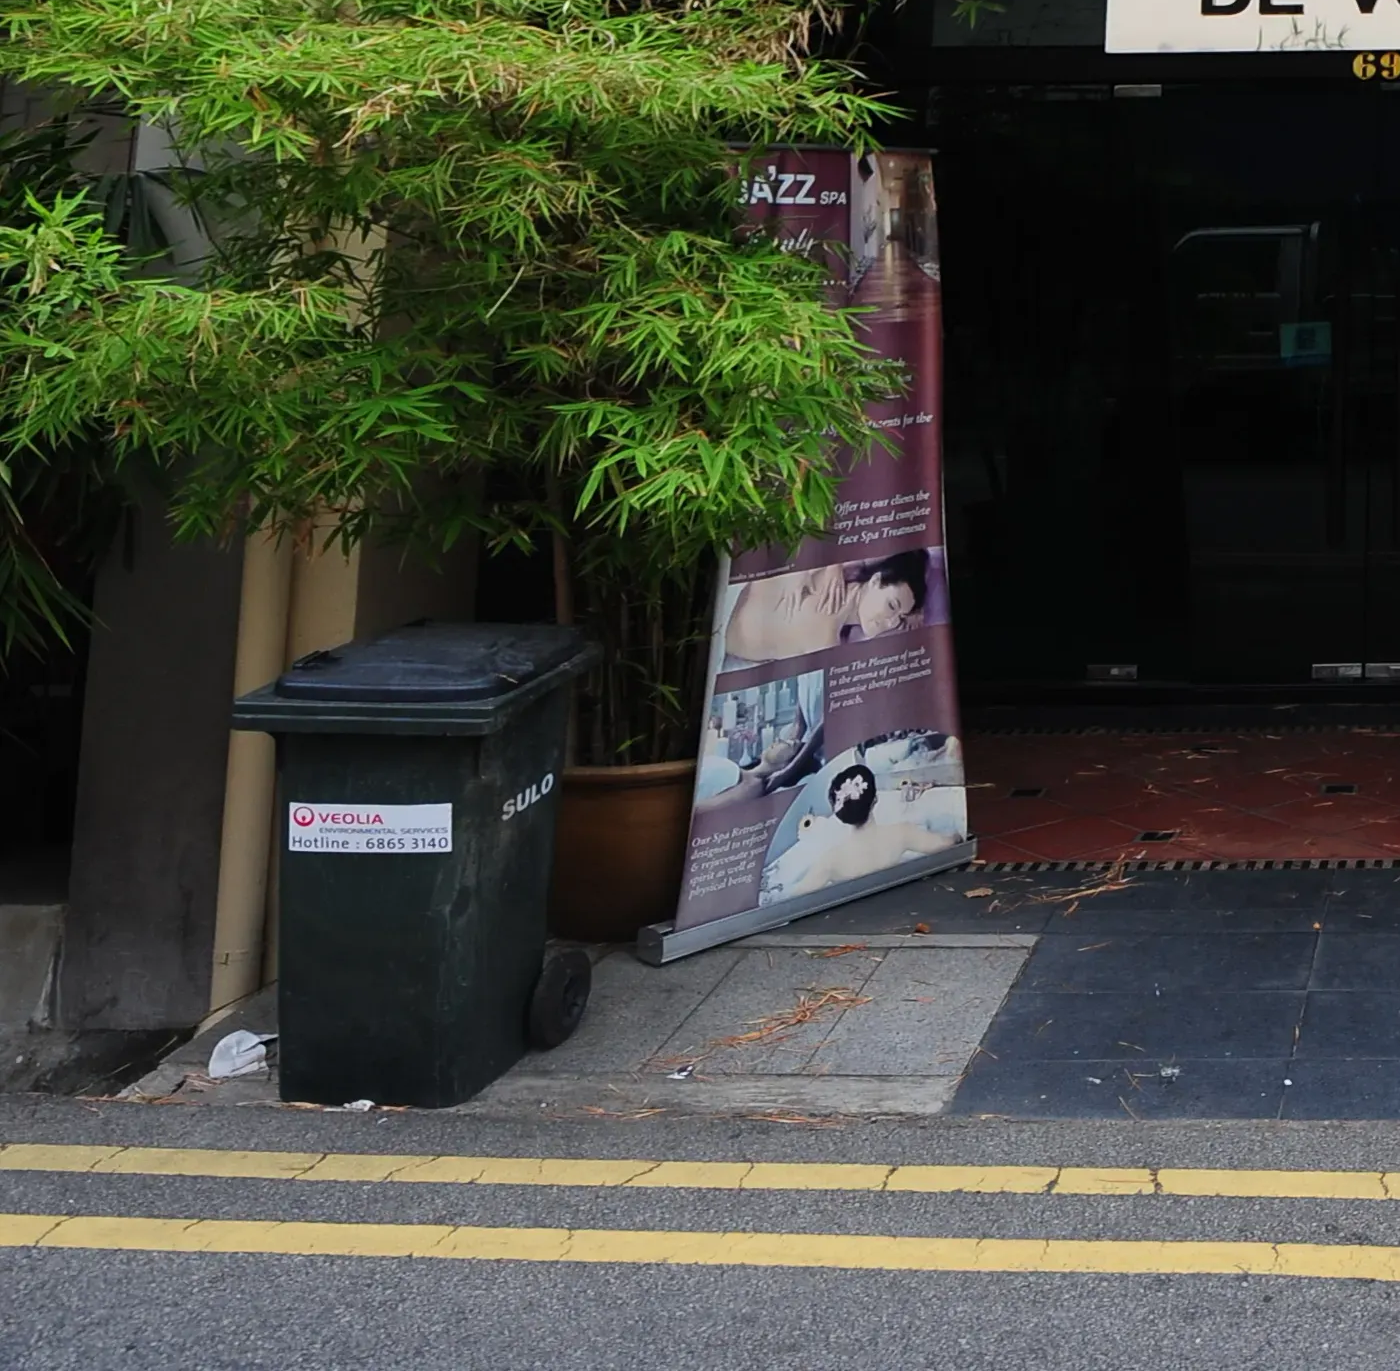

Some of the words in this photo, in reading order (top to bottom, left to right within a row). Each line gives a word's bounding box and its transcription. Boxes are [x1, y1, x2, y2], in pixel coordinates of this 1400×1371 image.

[820, 190, 847, 205] SPA
[834, 501, 859, 516] Offer
[860, 501, 870, 510] to
[871, 499, 889, 508] our
[854, 515, 874, 527] best
[837, 534, 859, 546] Face
[860, 530, 879, 544] Spa
[501, 772, 554, 821] SULO
[318, 812, 384, 825] VEOLIA
[319, 826, 397, 835] ENVIRONMENTAL
[400, 826, 449, 835] SERVICES
[292, 836, 350, 849] Hotline
[365, 837, 406, 850] 6865
[411, 837, 449, 849] 3140
